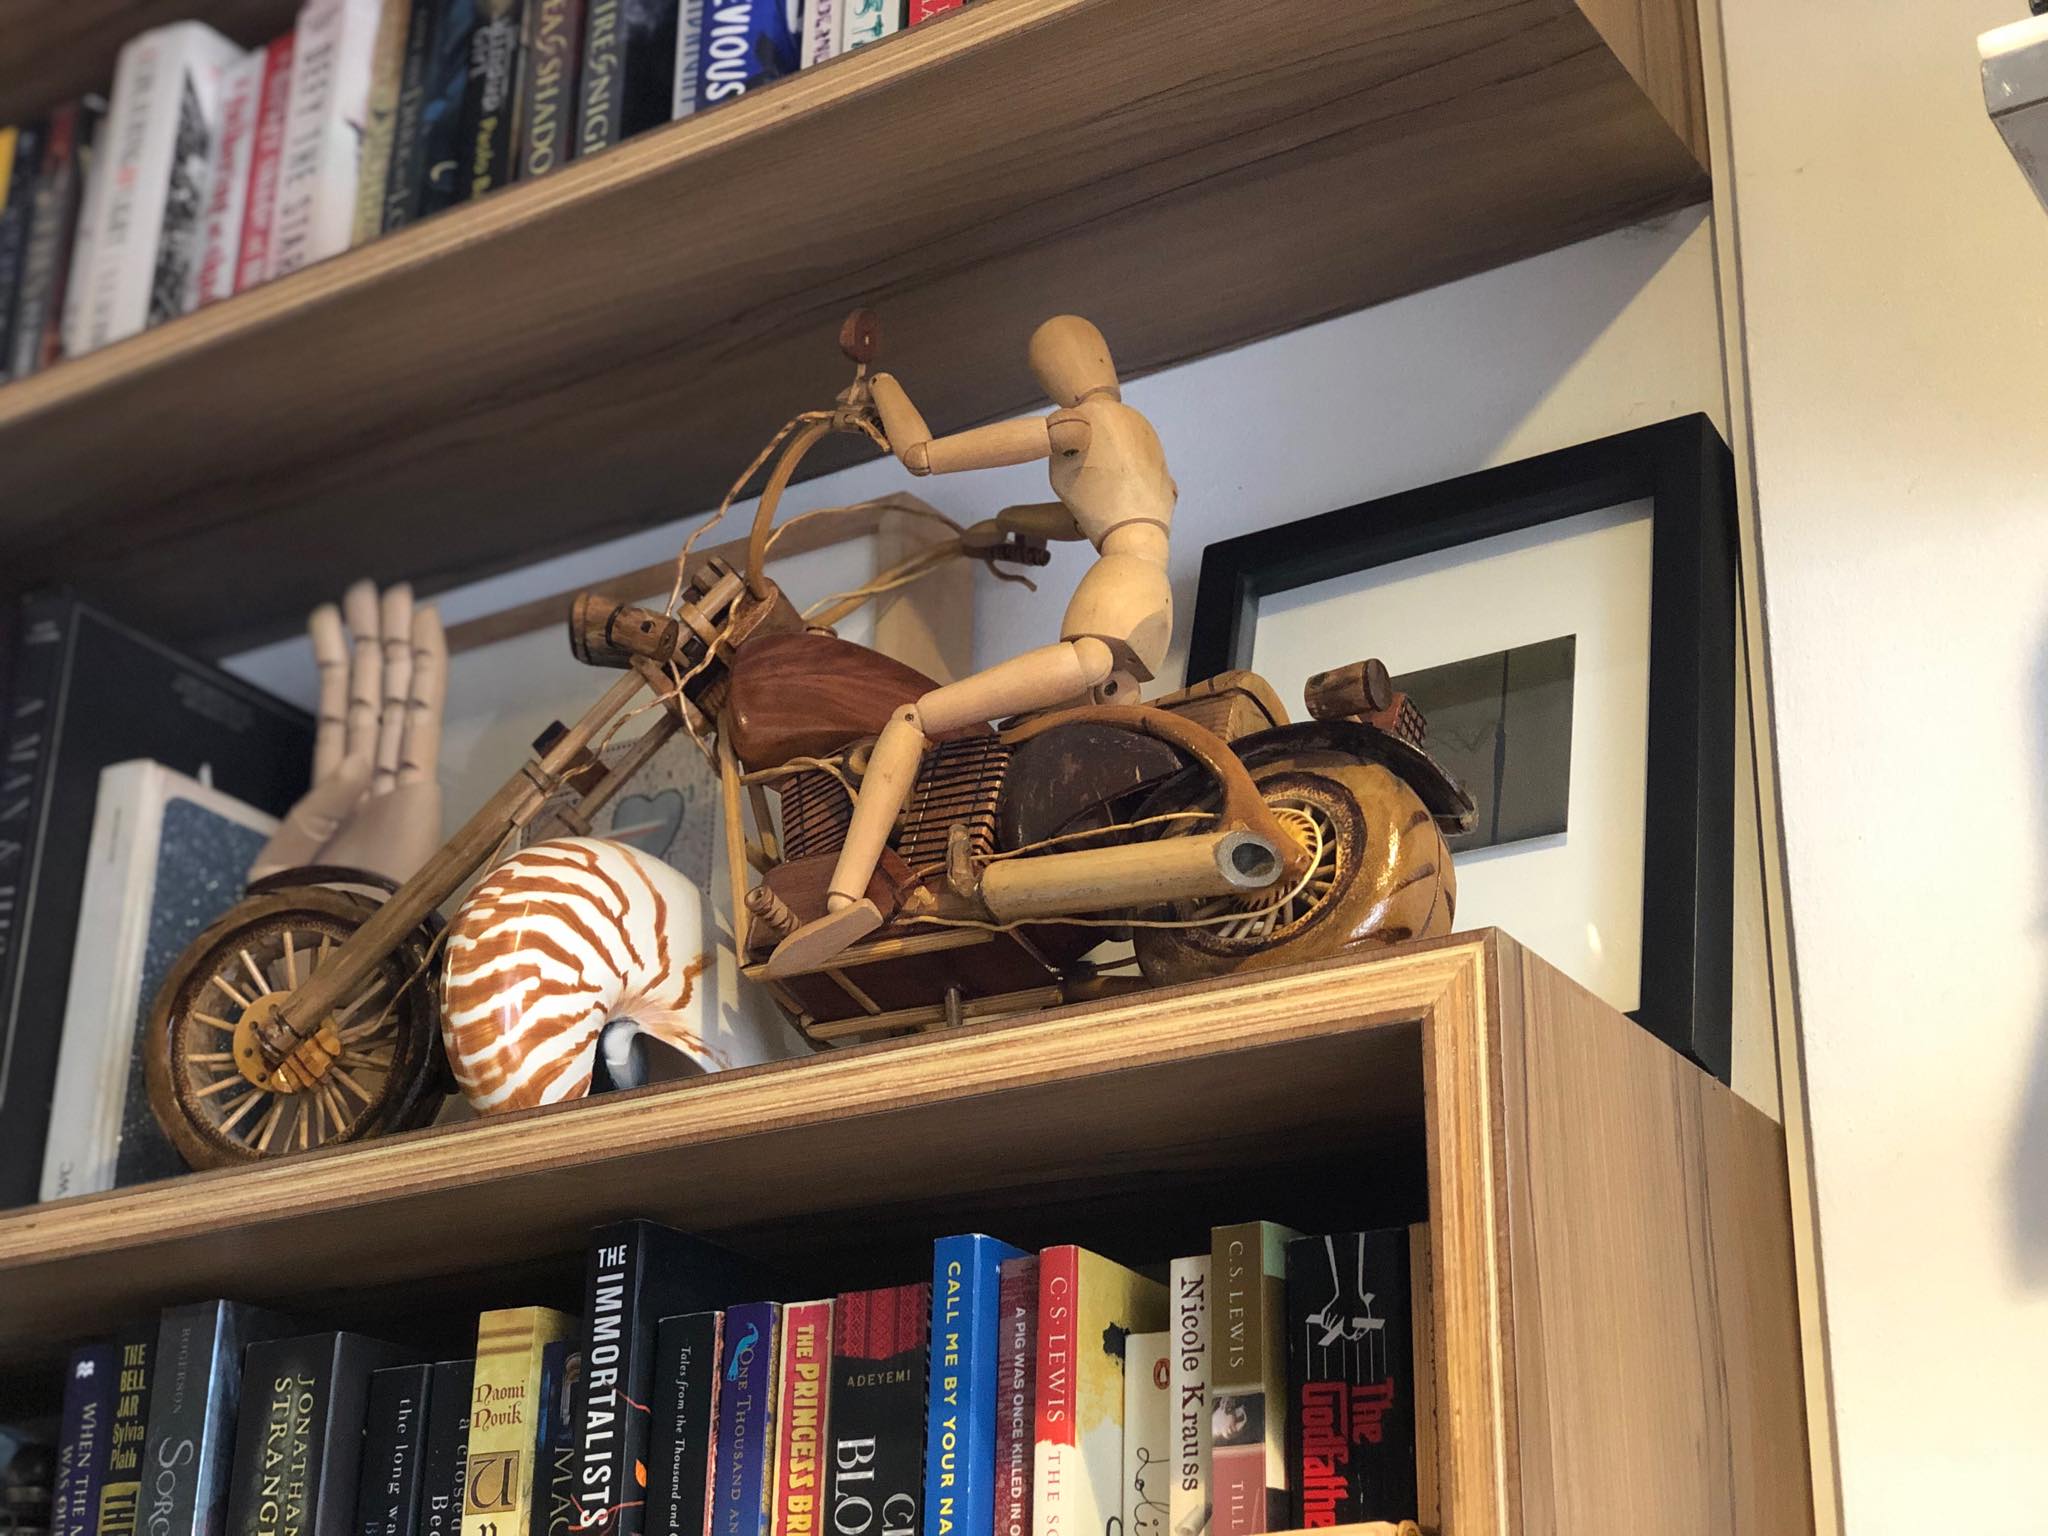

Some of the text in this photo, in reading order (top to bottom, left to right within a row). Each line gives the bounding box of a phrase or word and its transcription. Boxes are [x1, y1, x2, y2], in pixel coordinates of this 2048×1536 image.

[598, 1244, 627, 1268] THE
[946, 1261, 961, 1324] CALL
[1015, 1306, 1026, 1318] A
[1229, 1290, 1244, 1368] LEWIS
[944, 1333, 958, 1366] ME
[1014, 1321, 1025, 1349] PIG
[124, 1344, 147, 1366] THE
[680, 1346, 691, 1376] Tales
[1013, 1352, 1025, 1390] WAS
[120, 1369, 146, 1392] BELL
[475, 1379, 525, 1406] Naomi
[676, 1379, 689, 1411] from
[847, 1369, 911, 1387] ADEYEMI
[943, 1376, 958, 1406] BY
[1047, 1333, 1066, 1423] LEWIS
[1180, 1274, 1205, 1491] Nicole Krauss
[117, 1394, 139, 1418] JAR
[397, 1399, 412, 1434] the
[473, 1401, 522, 1432] Novik
[580, 1272, 624, 1528] IMMORTALISTS
[1011, 1393, 1024, 1438] ONCE
[1352, 1376, 1394, 1445] The
[78, 1402, 97, 1467] WHEN
[112, 1420, 145, 1448] Sylvia
[675, 1414, 687, 1433] the
[786, 1323, 820, 1536] THE PRINCESS BR
[110, 1448, 138, 1471] Plath
[731, 1394, 752, 1500] THOUSAND
[939, 1416, 957, 1488] YOUR
[59, 1445, 74, 1490] WAS
[388, 1445, 408, 1495] long
[671, 1438, 686, 1500] Thousand
[1009, 1442, 1023, 1499] KILLED
[1047, 1451, 1061, 1501] THE
[72, 1475, 88, 1517] THE
[1009, 1502, 1021, 1520] IN
[1231, 1481, 1244, 1529] TILL
[669, 1504, 680, 1528] and
